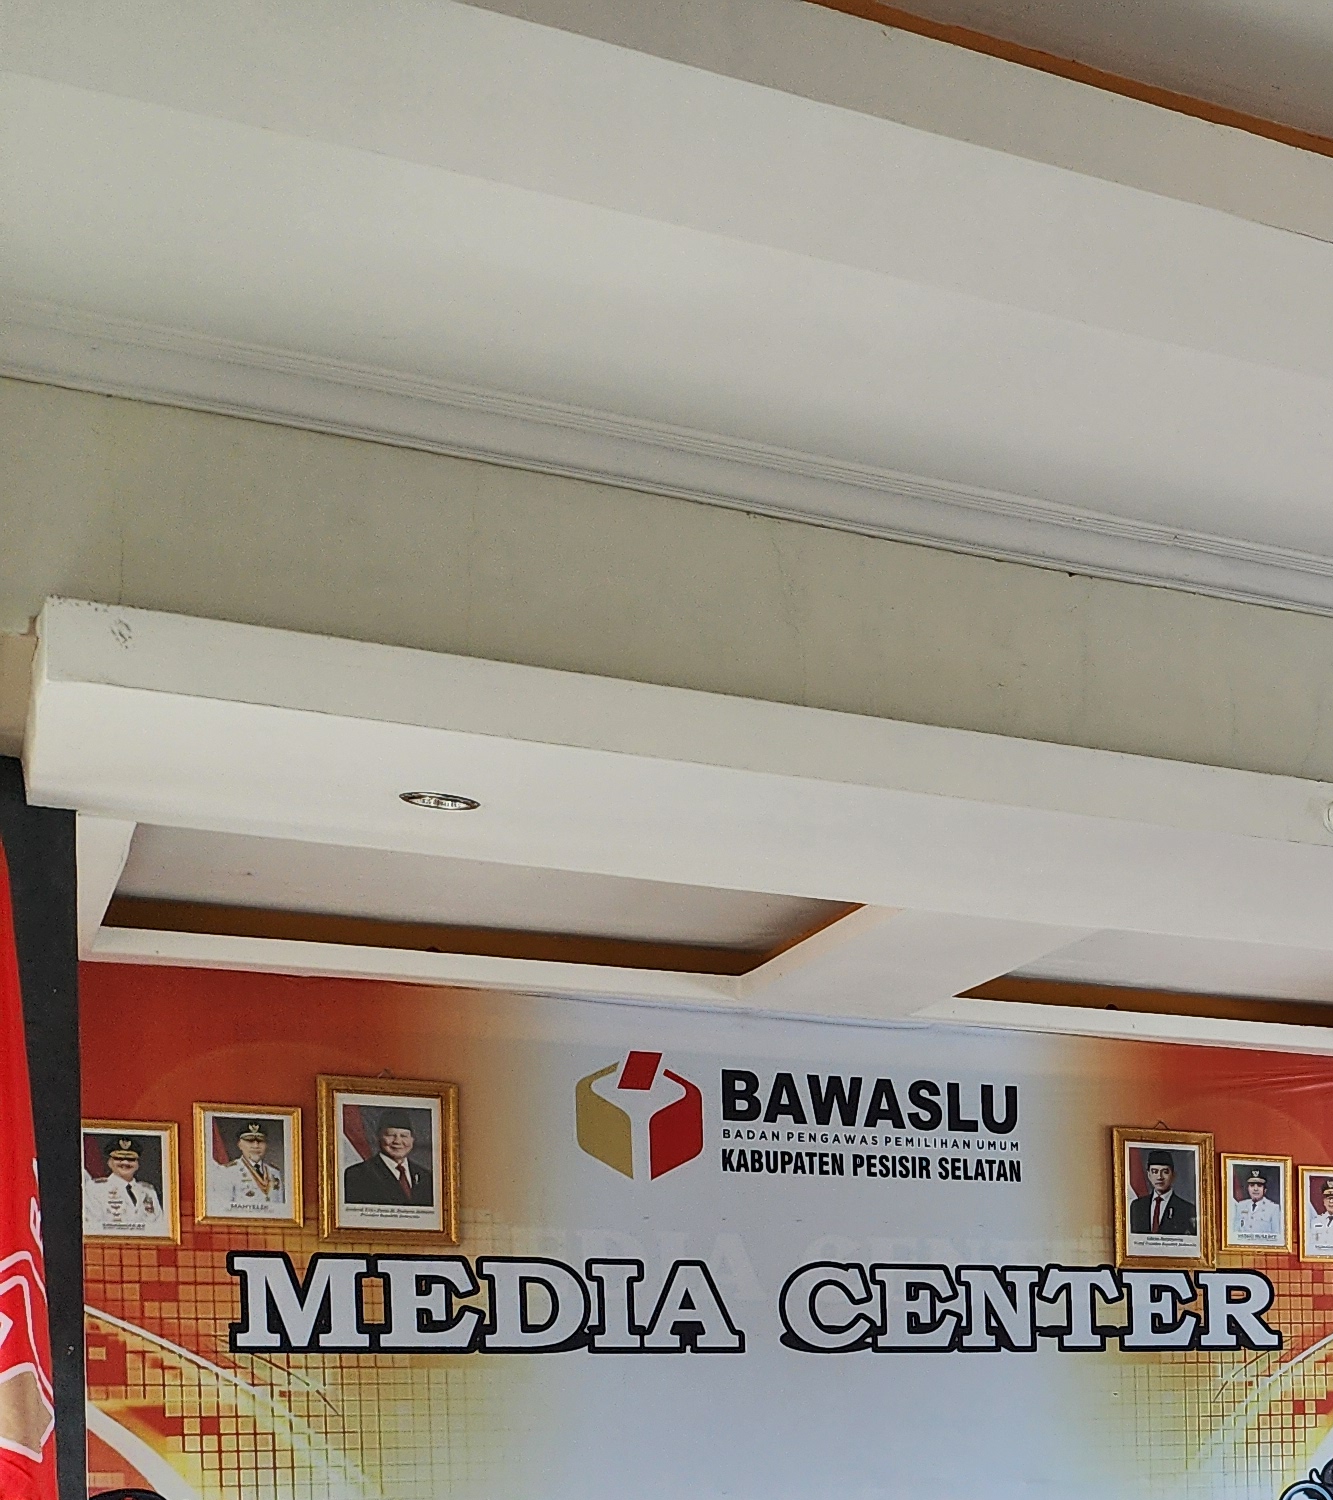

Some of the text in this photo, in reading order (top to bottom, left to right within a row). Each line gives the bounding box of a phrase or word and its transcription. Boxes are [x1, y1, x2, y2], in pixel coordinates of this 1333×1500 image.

[721, 1068, 1018, 1134] BAWASLU
[722, 1128, 1019, 1151] BADAN PENGAWAS PEMILIHAN UMUM
[721, 1148, 1021, 1182] KABUPATEN PESISIR SELATAN
[228, 1252, 1283, 1354] MEDIA CENTER
